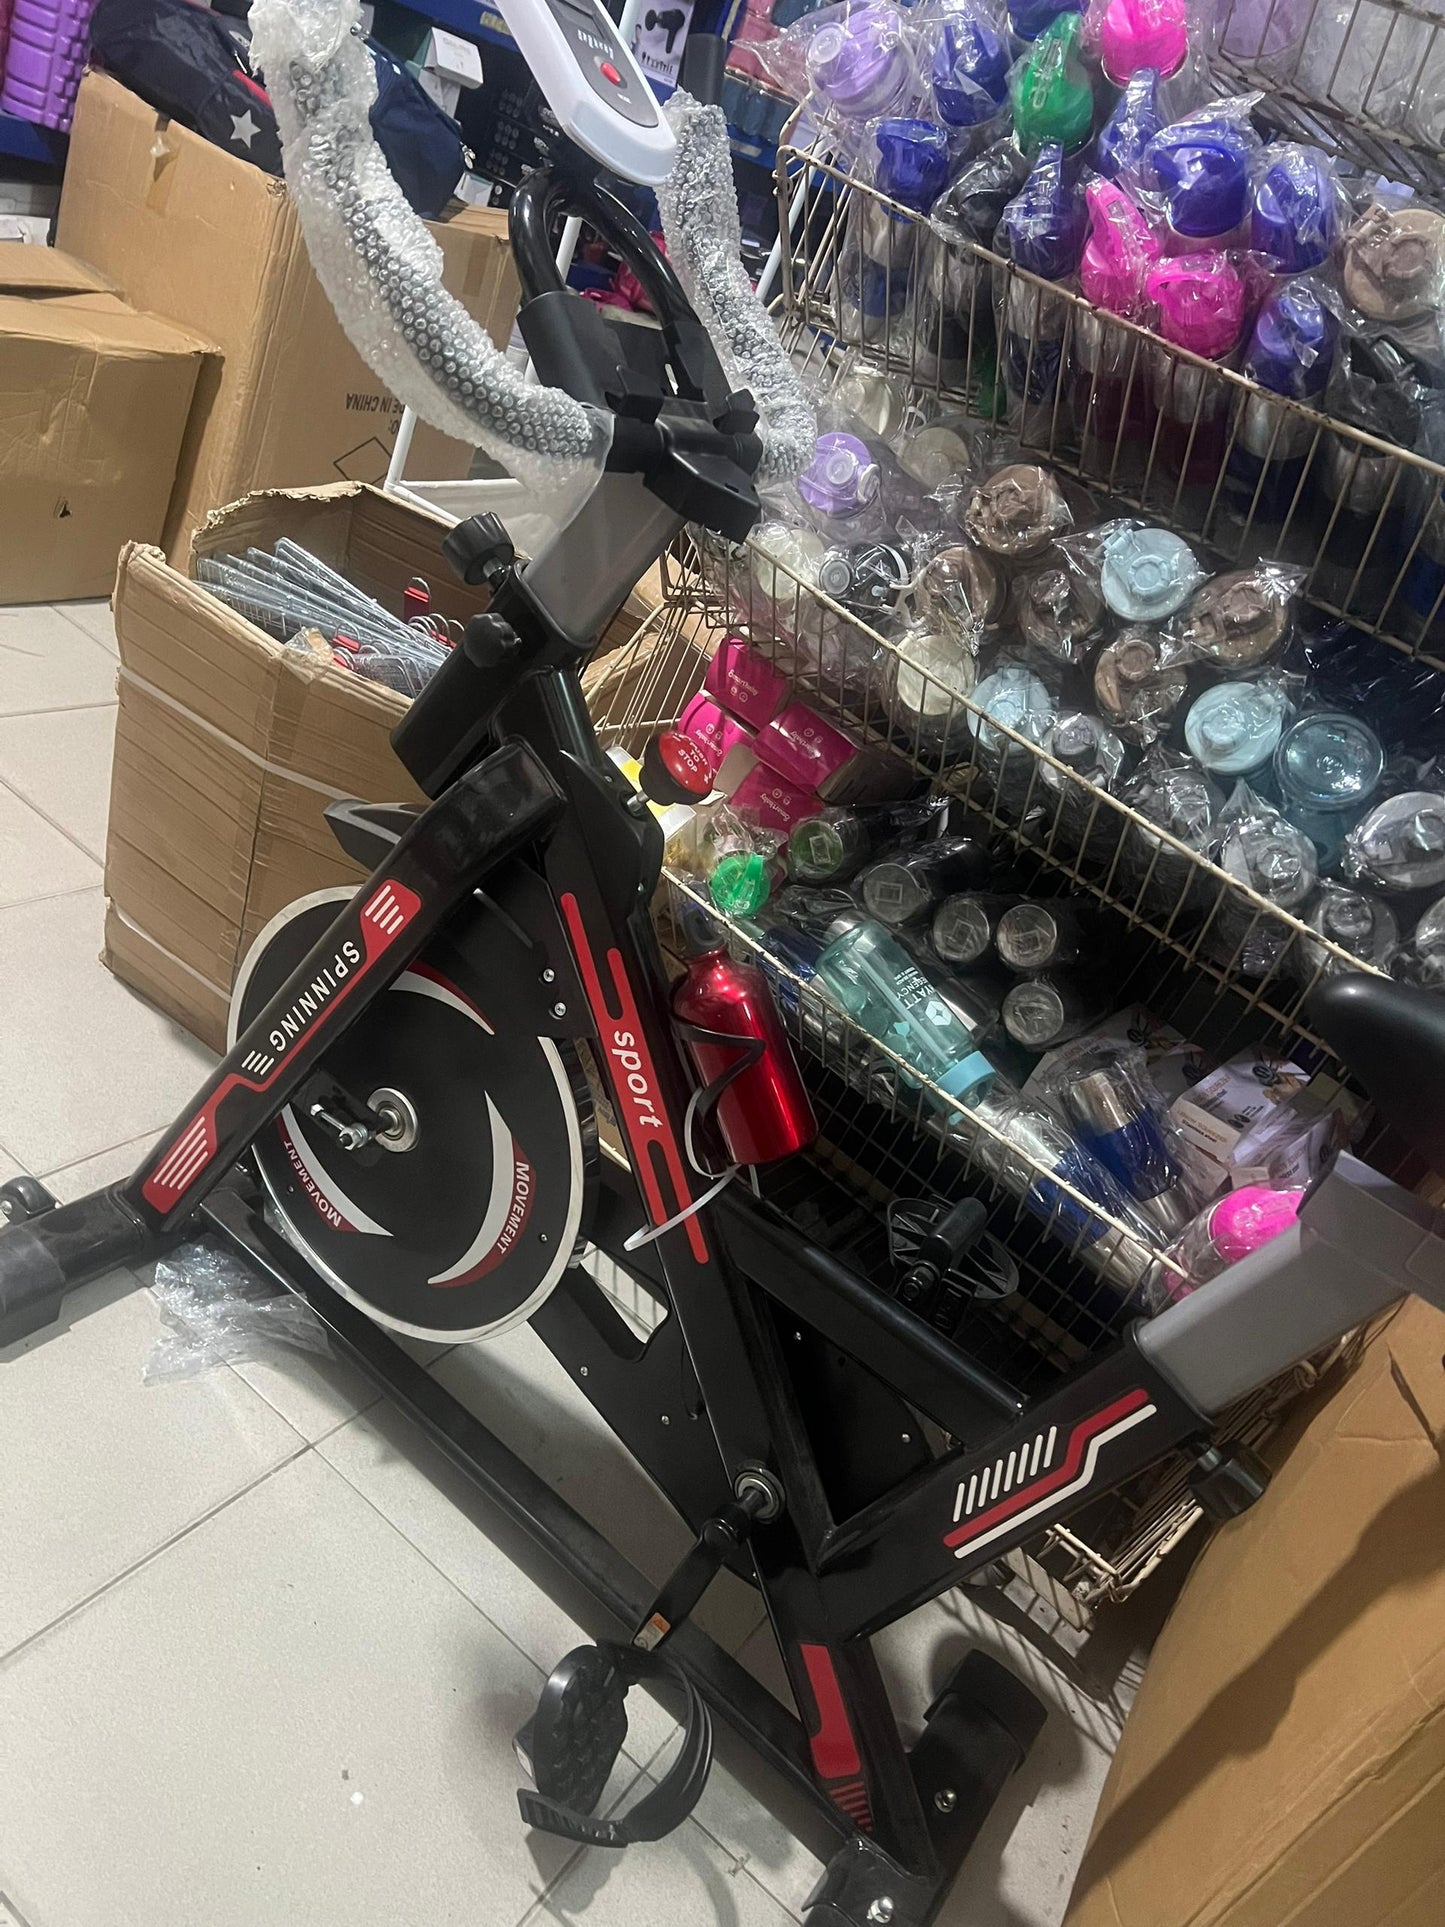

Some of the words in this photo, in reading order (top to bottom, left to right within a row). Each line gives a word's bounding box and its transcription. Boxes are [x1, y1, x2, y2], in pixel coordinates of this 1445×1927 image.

[345, 393, 380, 412] CHINA
[380, 396, 393, 413] IN
[678, 749, 698, 772] STOP
[690, 749, 700, 762] TO
[269, 941, 360, 1052] SPINNING
[611, 1030, 663, 1128] sport
[283, 1140, 342, 1228] MOVEMENT
[496, 1161, 530, 1254] MOVEMENT
